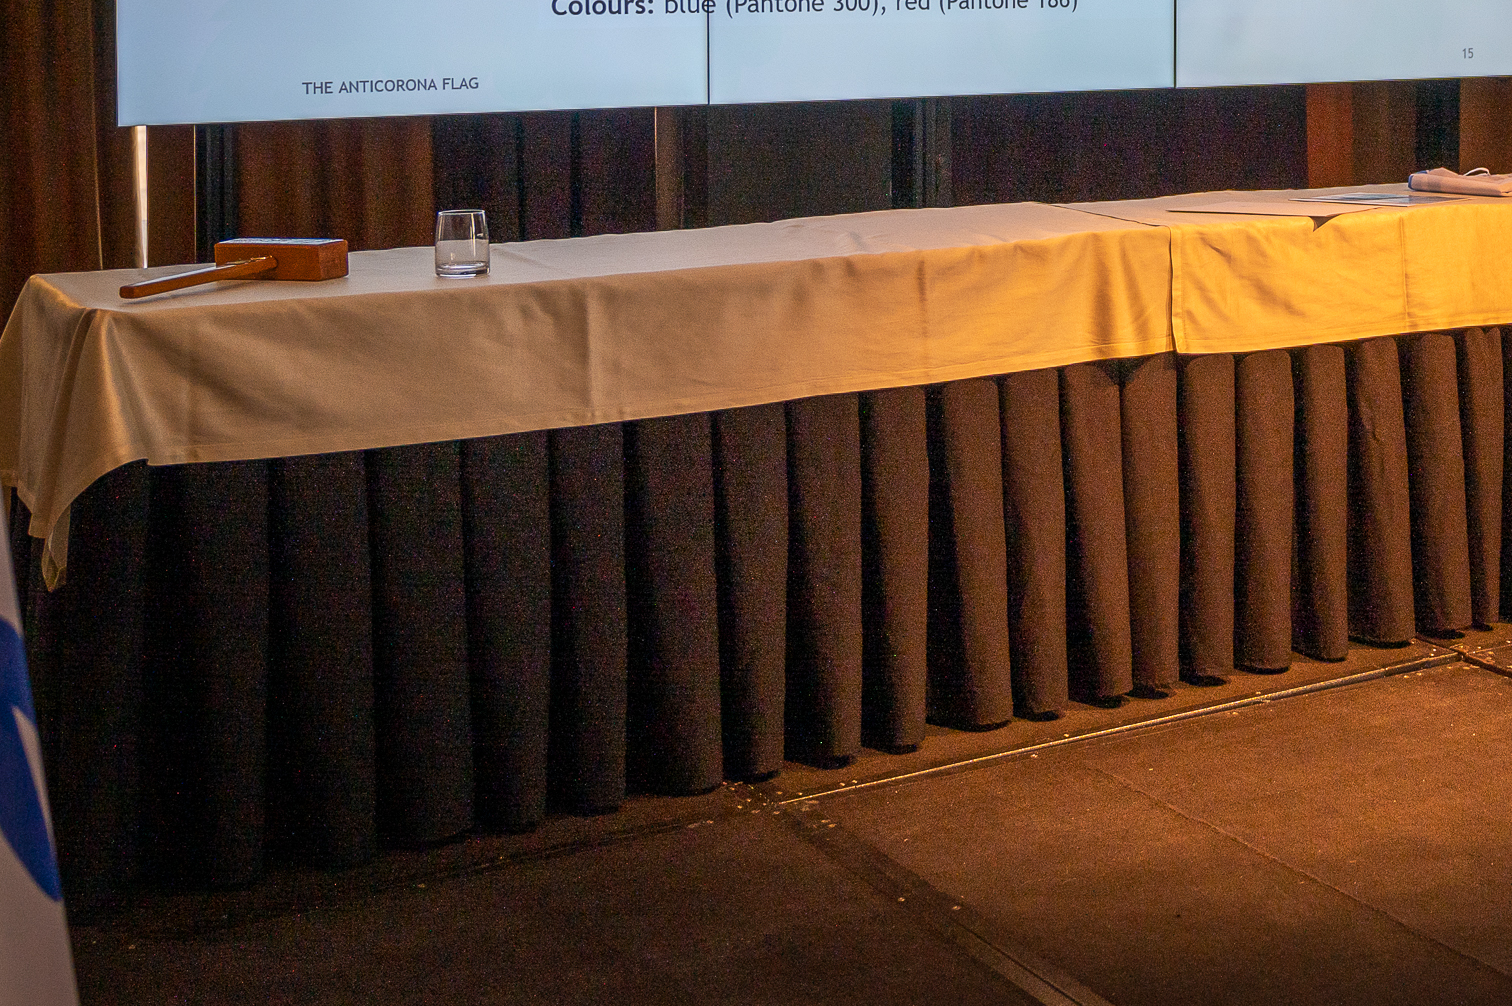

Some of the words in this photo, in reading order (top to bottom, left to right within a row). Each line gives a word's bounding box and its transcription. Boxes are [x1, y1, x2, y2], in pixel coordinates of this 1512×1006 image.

[1462, 47, 1474, 59] 15
[302, 81, 333, 95] THE
[338, 78, 437, 93] ANTICORONA
[442, 77, 479, 91] FLAG
